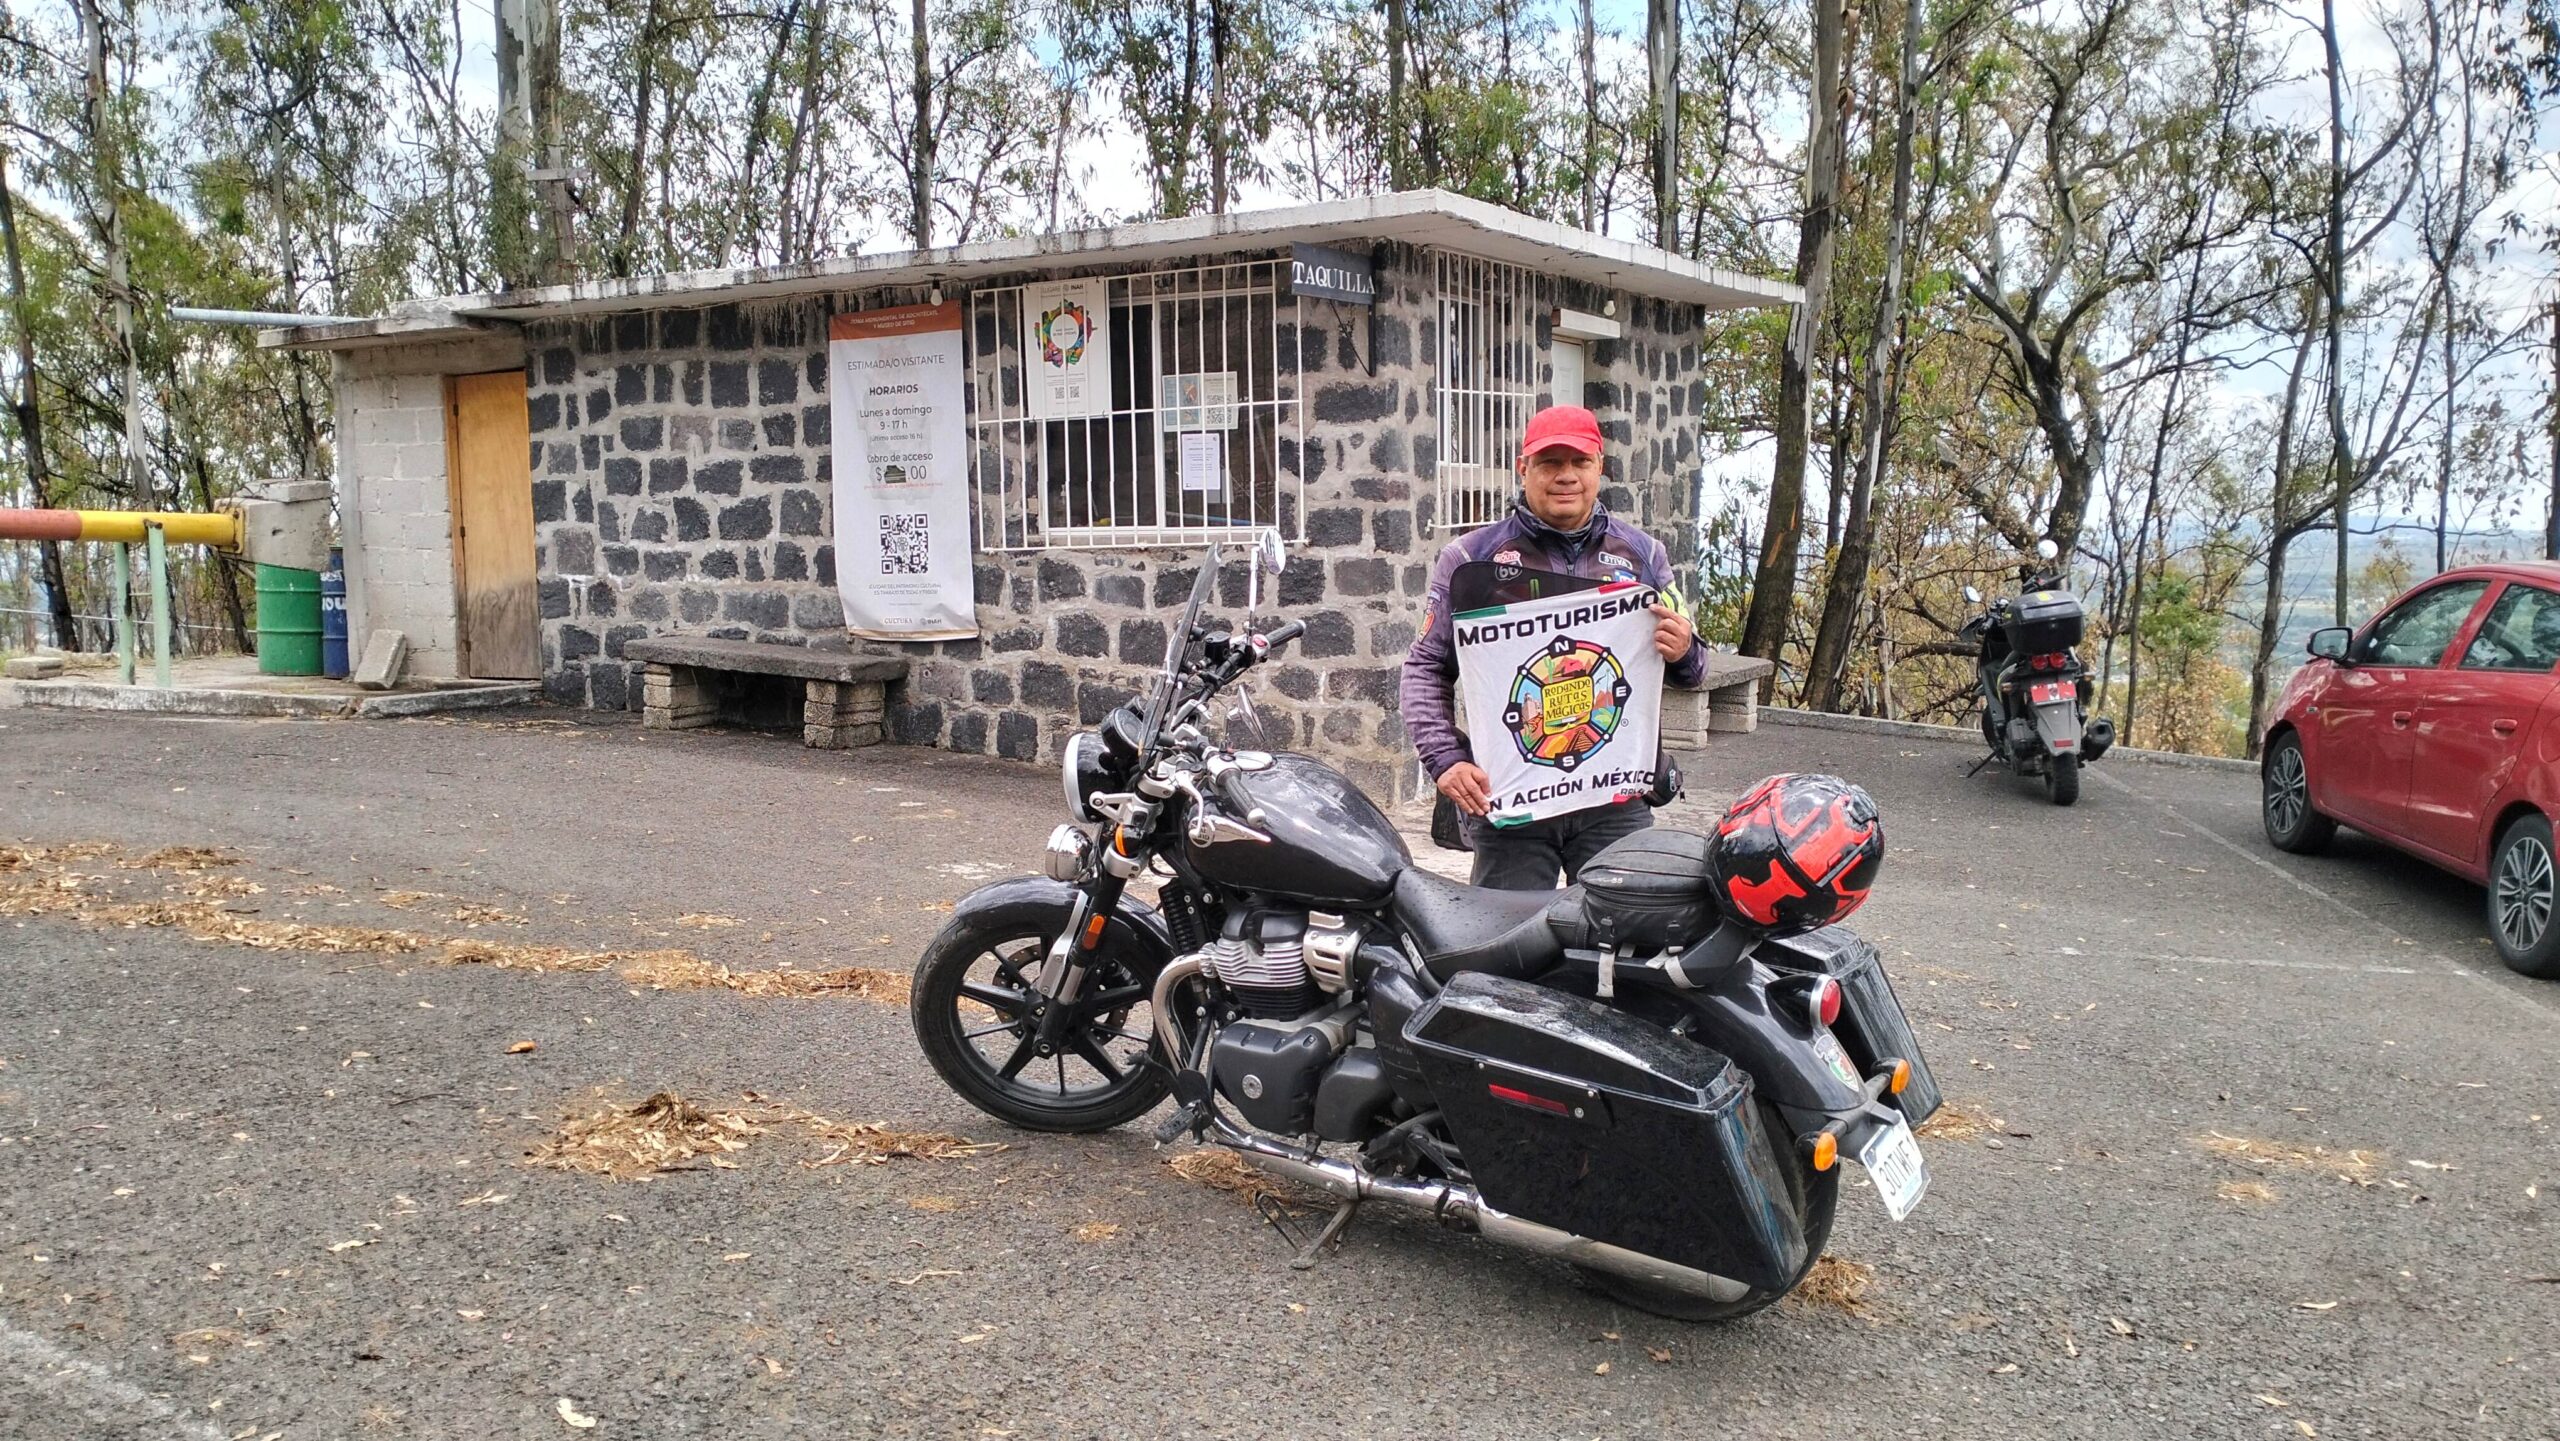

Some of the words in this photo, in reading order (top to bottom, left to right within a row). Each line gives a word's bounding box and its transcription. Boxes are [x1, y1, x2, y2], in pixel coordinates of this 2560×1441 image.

[1292, 261, 1376, 294] TAQUILLA
[847, 357, 900, 371] ESTIMADA/O
[901, 354, 945, 367] VISITANTE
[869, 384, 919, 396] HORARIOS
[860, 408, 884, 418] Lunes
[892, 405, 933, 417] domingo
[880, 421, 885, 430] 9
[891, 420, 900, 429] 17
[902, 420, 908, 429] h
[867, 454, 889, 464] Cobro
[890, 452, 901, 462] de
[902, 453, 933, 462] acceso
[1499, 565, 1519, 579] 66
[1457, 591, 1659, 647] MOTOTURISMO
[1555, 641, 1570, 653] N
[1615, 686, 1627, 697] E
[1506, 711, 1520, 721] O
[1562, 755, 1575, 767] S
[1512, 777, 1583, 808] ACCIÓN
[1592, 767, 1655, 790] MÉXICO
